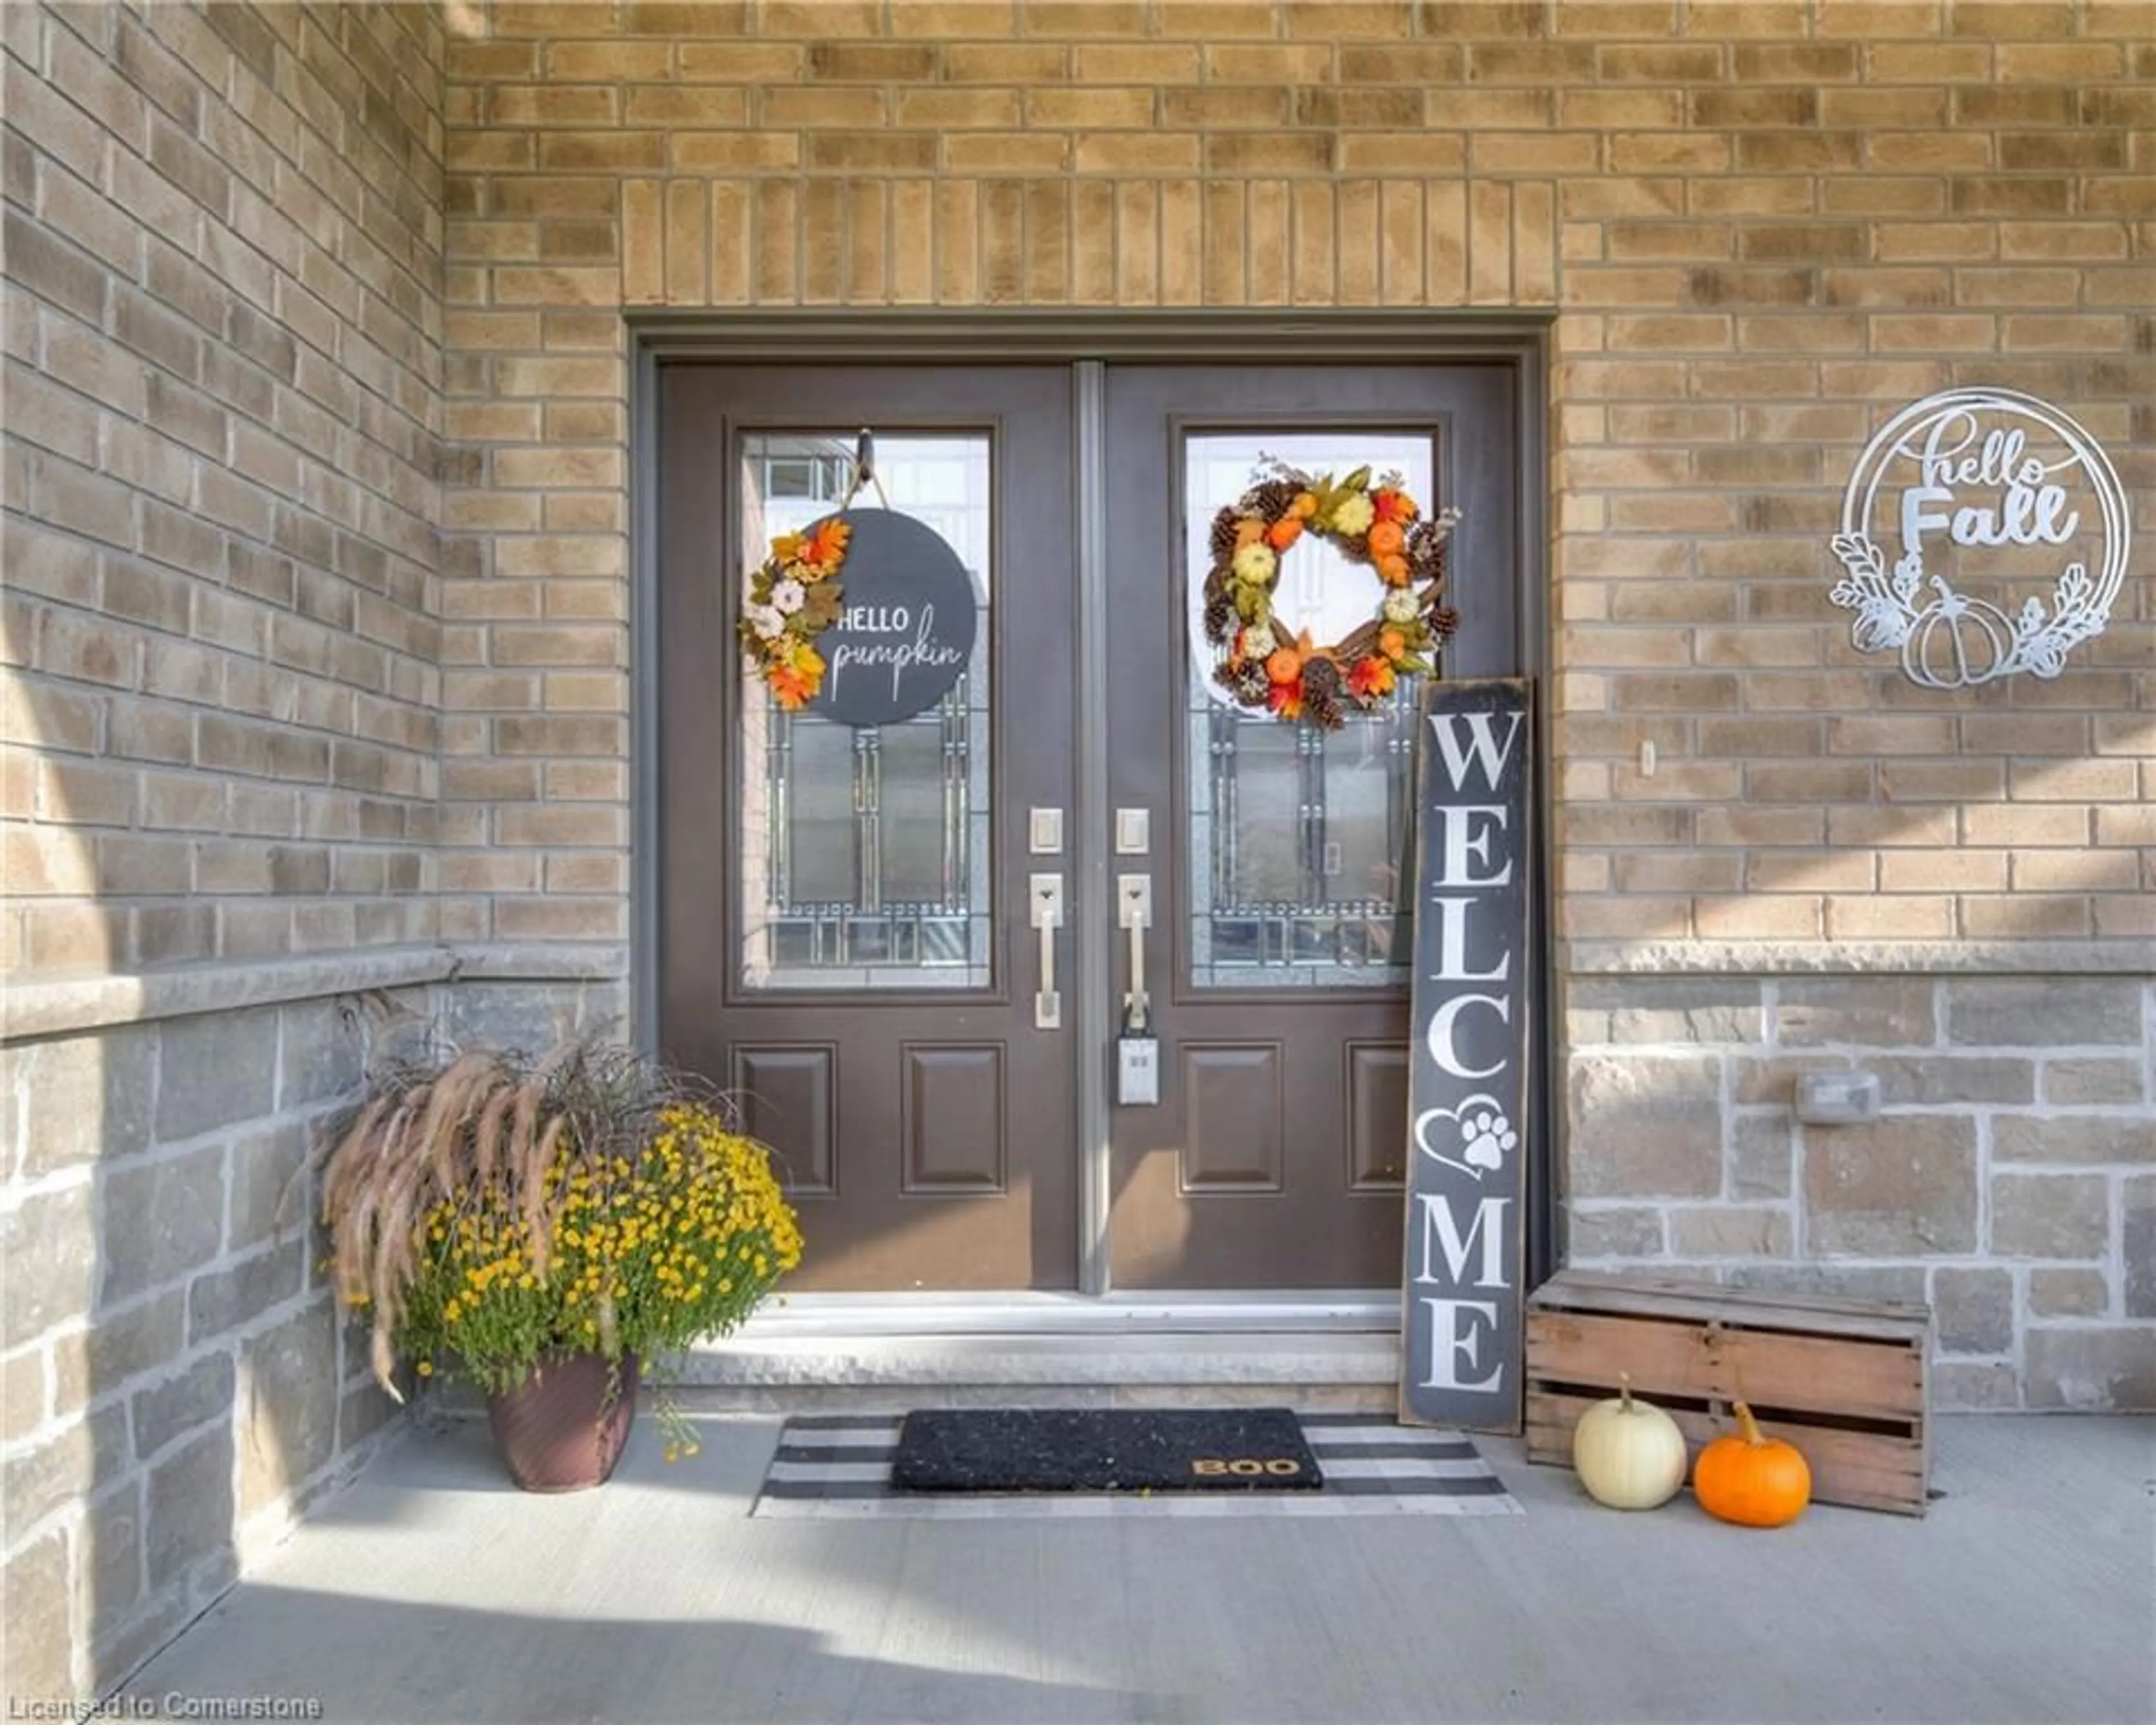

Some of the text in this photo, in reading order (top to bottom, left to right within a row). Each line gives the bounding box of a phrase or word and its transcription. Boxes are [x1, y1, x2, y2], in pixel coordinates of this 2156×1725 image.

[1898, 409, 2081, 486] hello
[1902, 485, 2079, 553] Fall
[831, 603, 962, 702] pumpkin
[837, 607, 908, 632] HELLO
[1192, 1459, 1300, 1475] BOO
